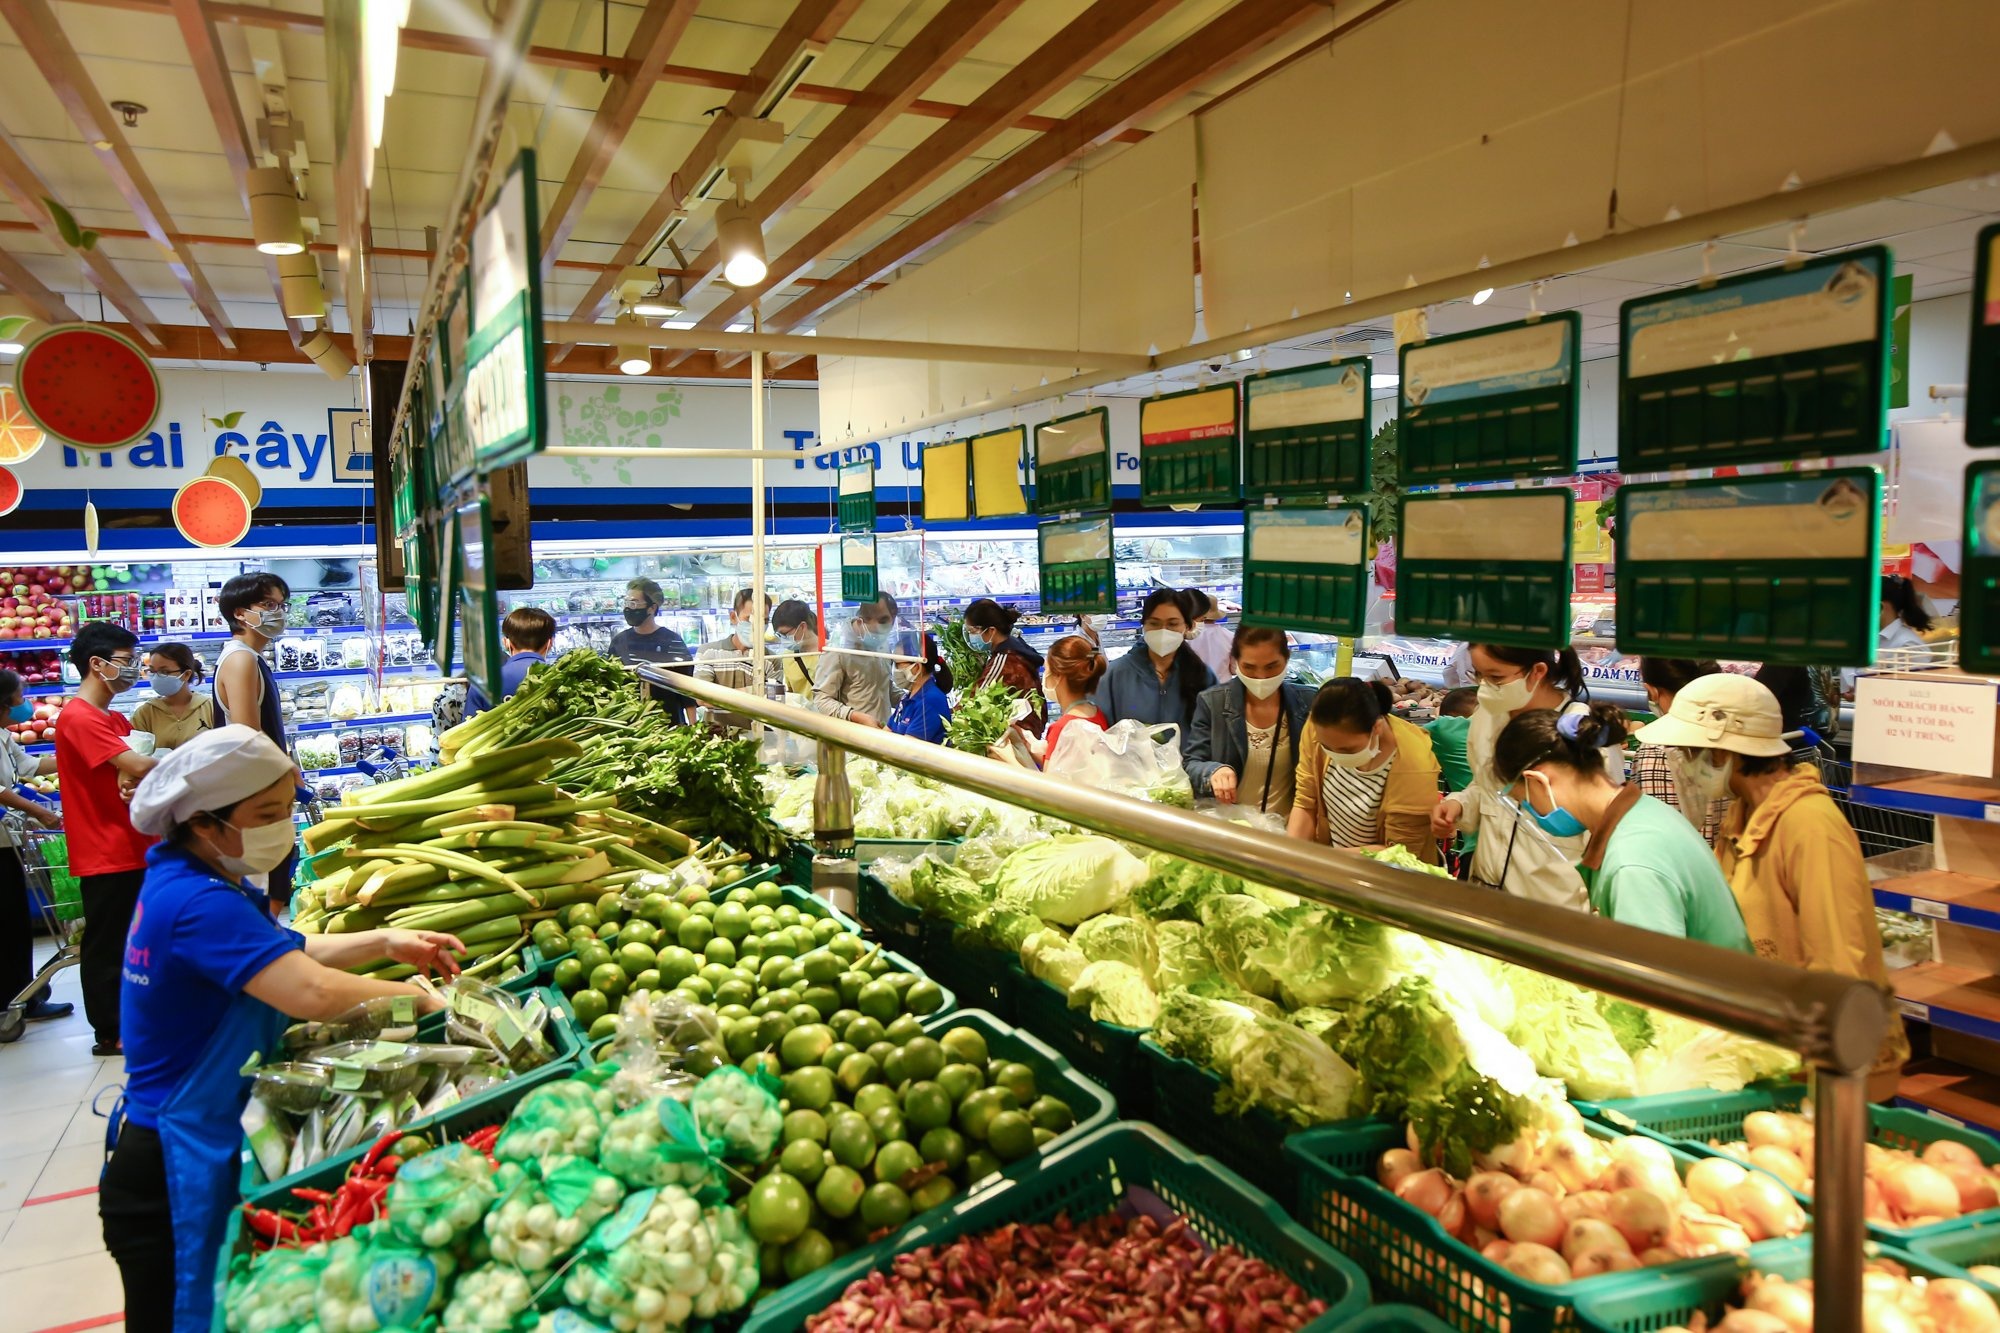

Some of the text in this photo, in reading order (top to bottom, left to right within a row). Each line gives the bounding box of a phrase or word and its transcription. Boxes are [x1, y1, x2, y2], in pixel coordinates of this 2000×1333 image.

[214, 420, 328, 481] cây
[1116, 452, 1141, 471] Fo
[1416, 655, 1438, 666] SINH
[128, 946, 150, 968] art
